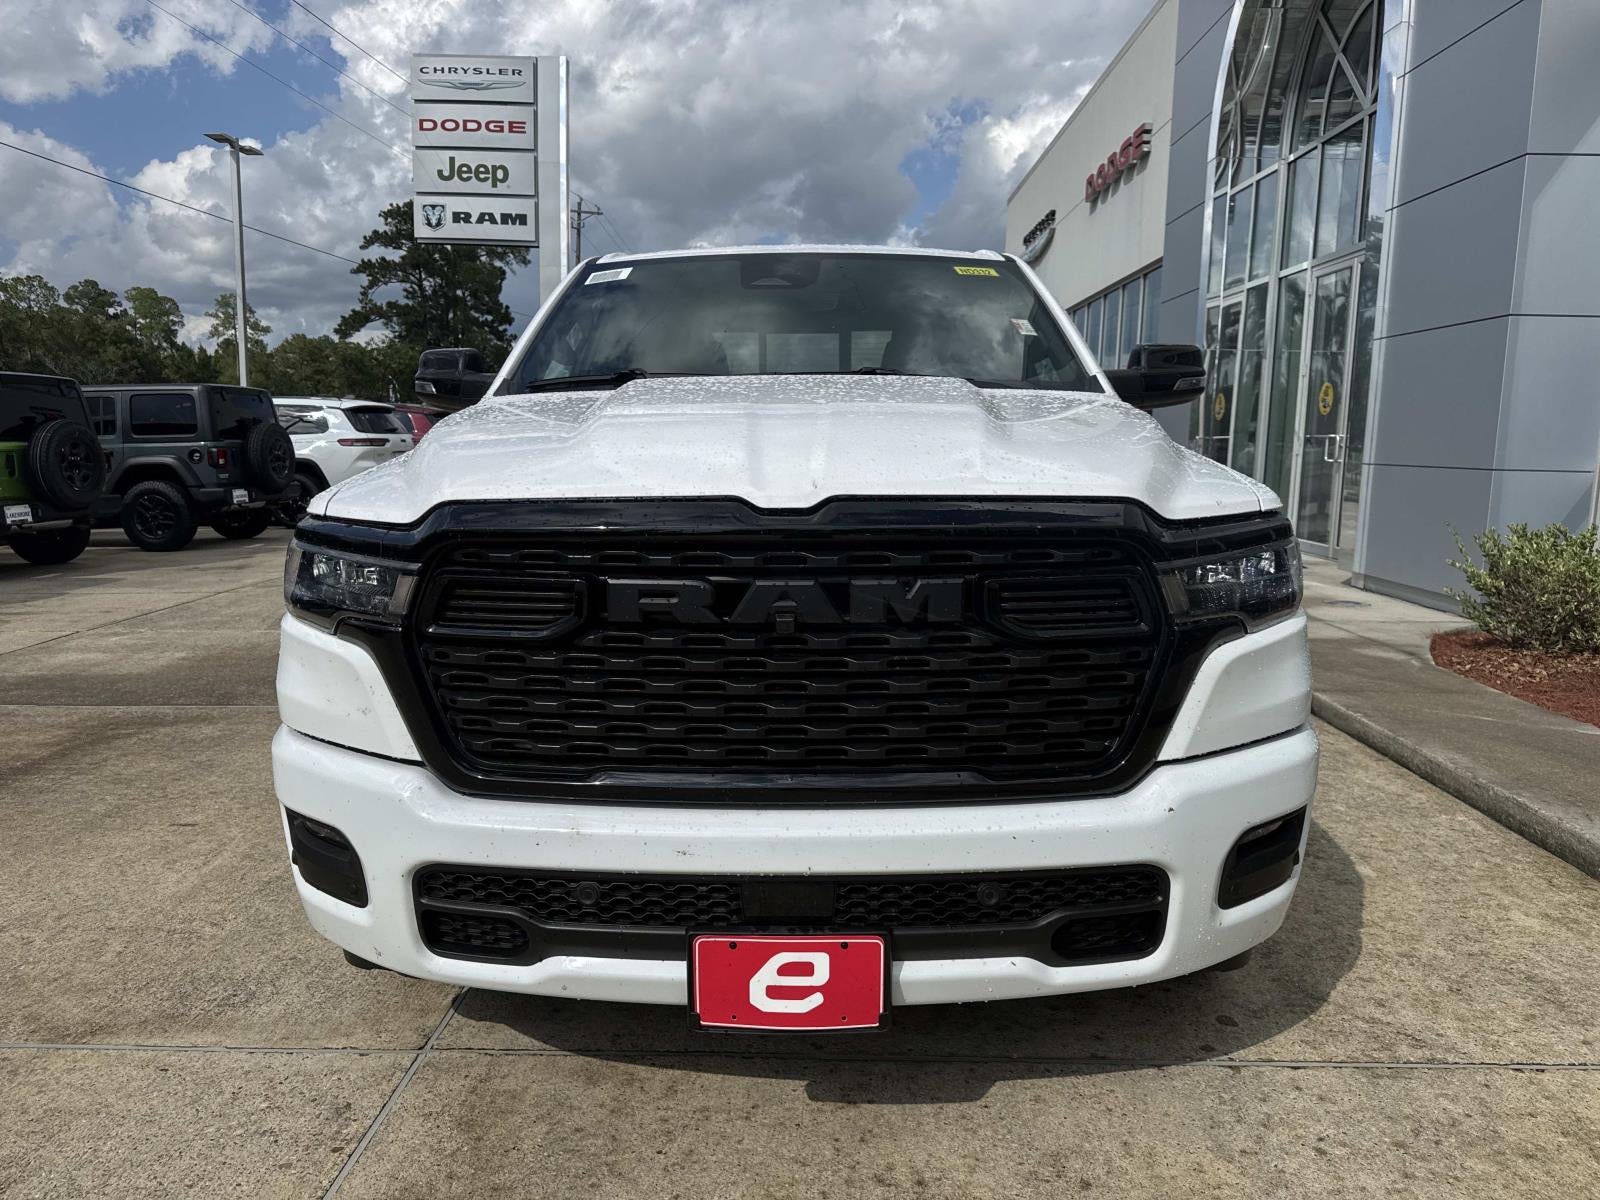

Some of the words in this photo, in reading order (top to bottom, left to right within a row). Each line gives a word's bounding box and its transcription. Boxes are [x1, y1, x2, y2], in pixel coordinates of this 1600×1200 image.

[419, 66, 523, 77] CHRYSLER
[418, 118, 527, 134] DODGE
[436, 156, 510, 188] Jeep
[1085, 122, 1153, 203] DODGE
[451, 211, 528, 227] RAM
[606, 577, 966, 623] RAM
[749, 951, 830, 1014] e
